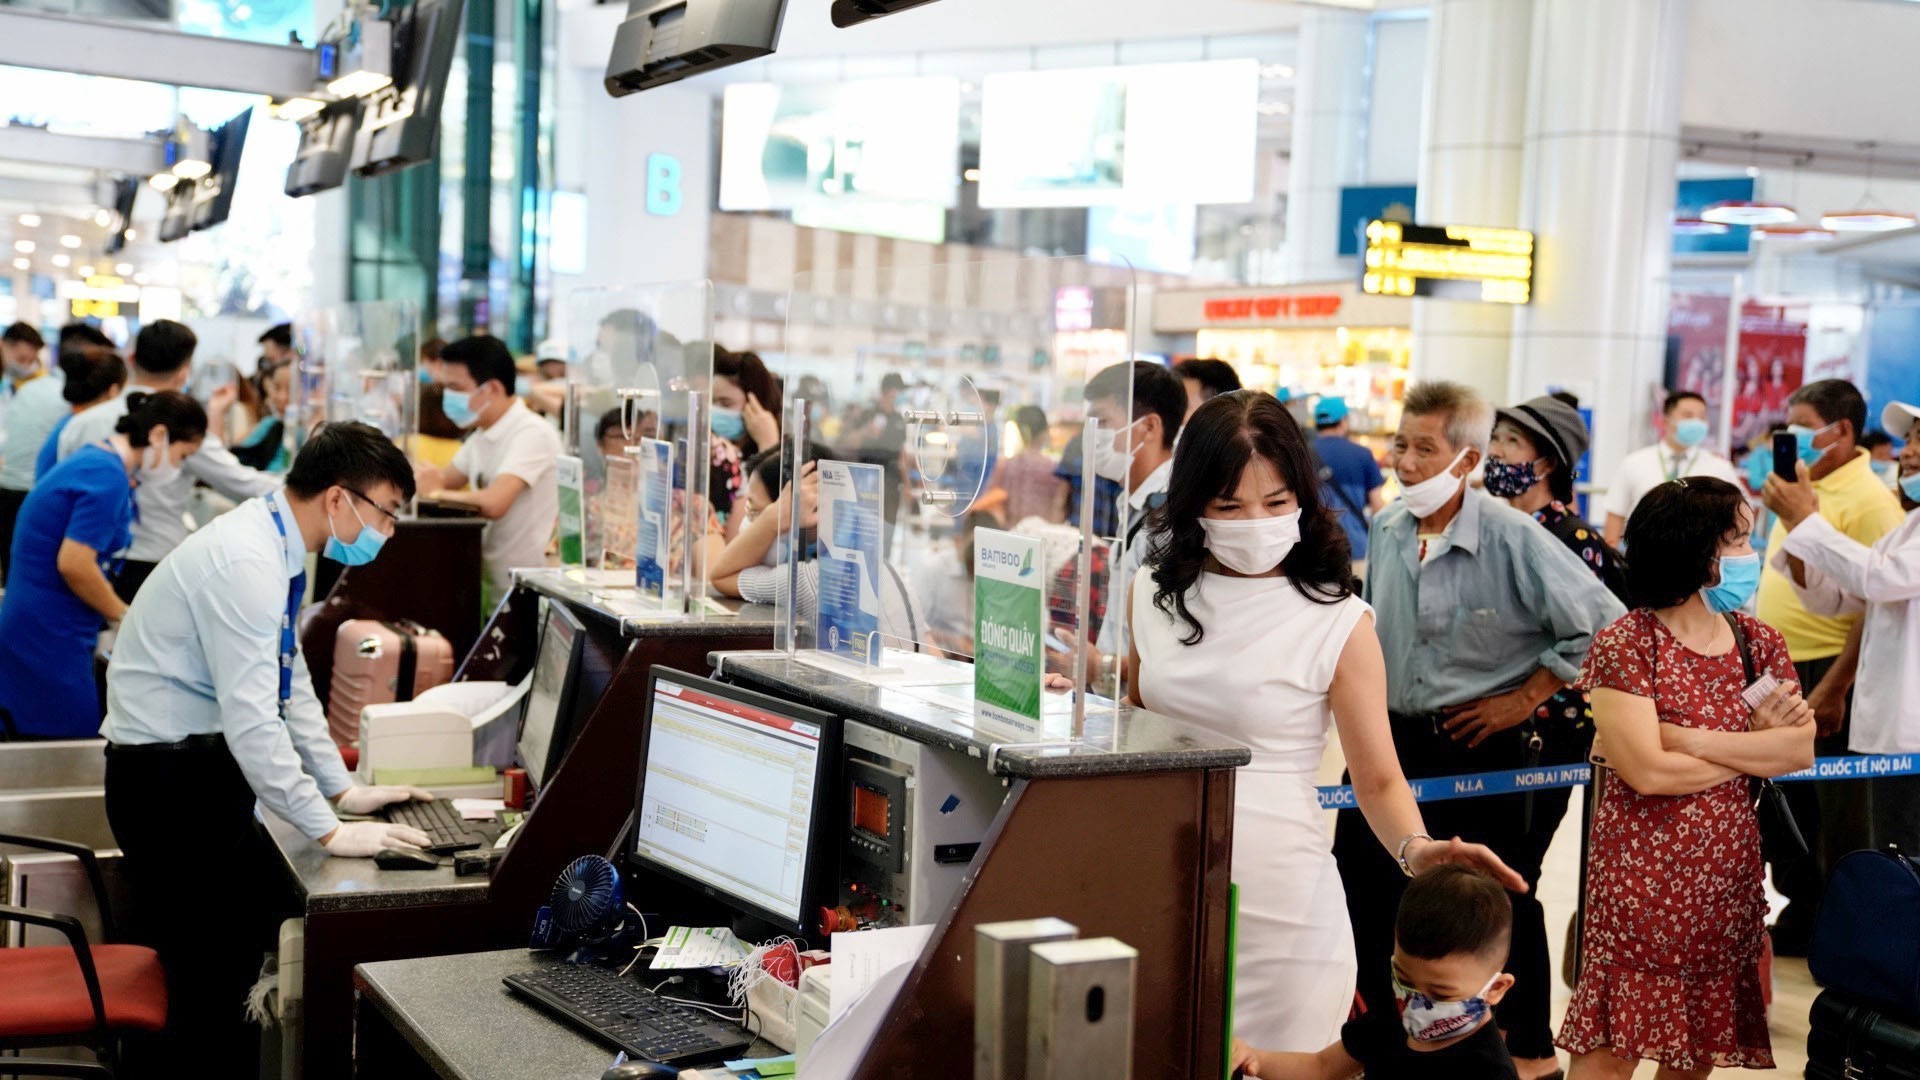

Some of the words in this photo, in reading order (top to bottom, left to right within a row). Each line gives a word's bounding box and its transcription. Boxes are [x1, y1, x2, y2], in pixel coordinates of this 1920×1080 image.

[645, 153, 682, 216] B
[981, 547, 1020, 567] BAMBOO
[981, 616, 1007, 649] ĐÓNG
[1820, 758, 1851, 777] QUỐC
[1870, 756, 1890, 775] NỘI
[1455, 778, 1484, 793] N.I.A
